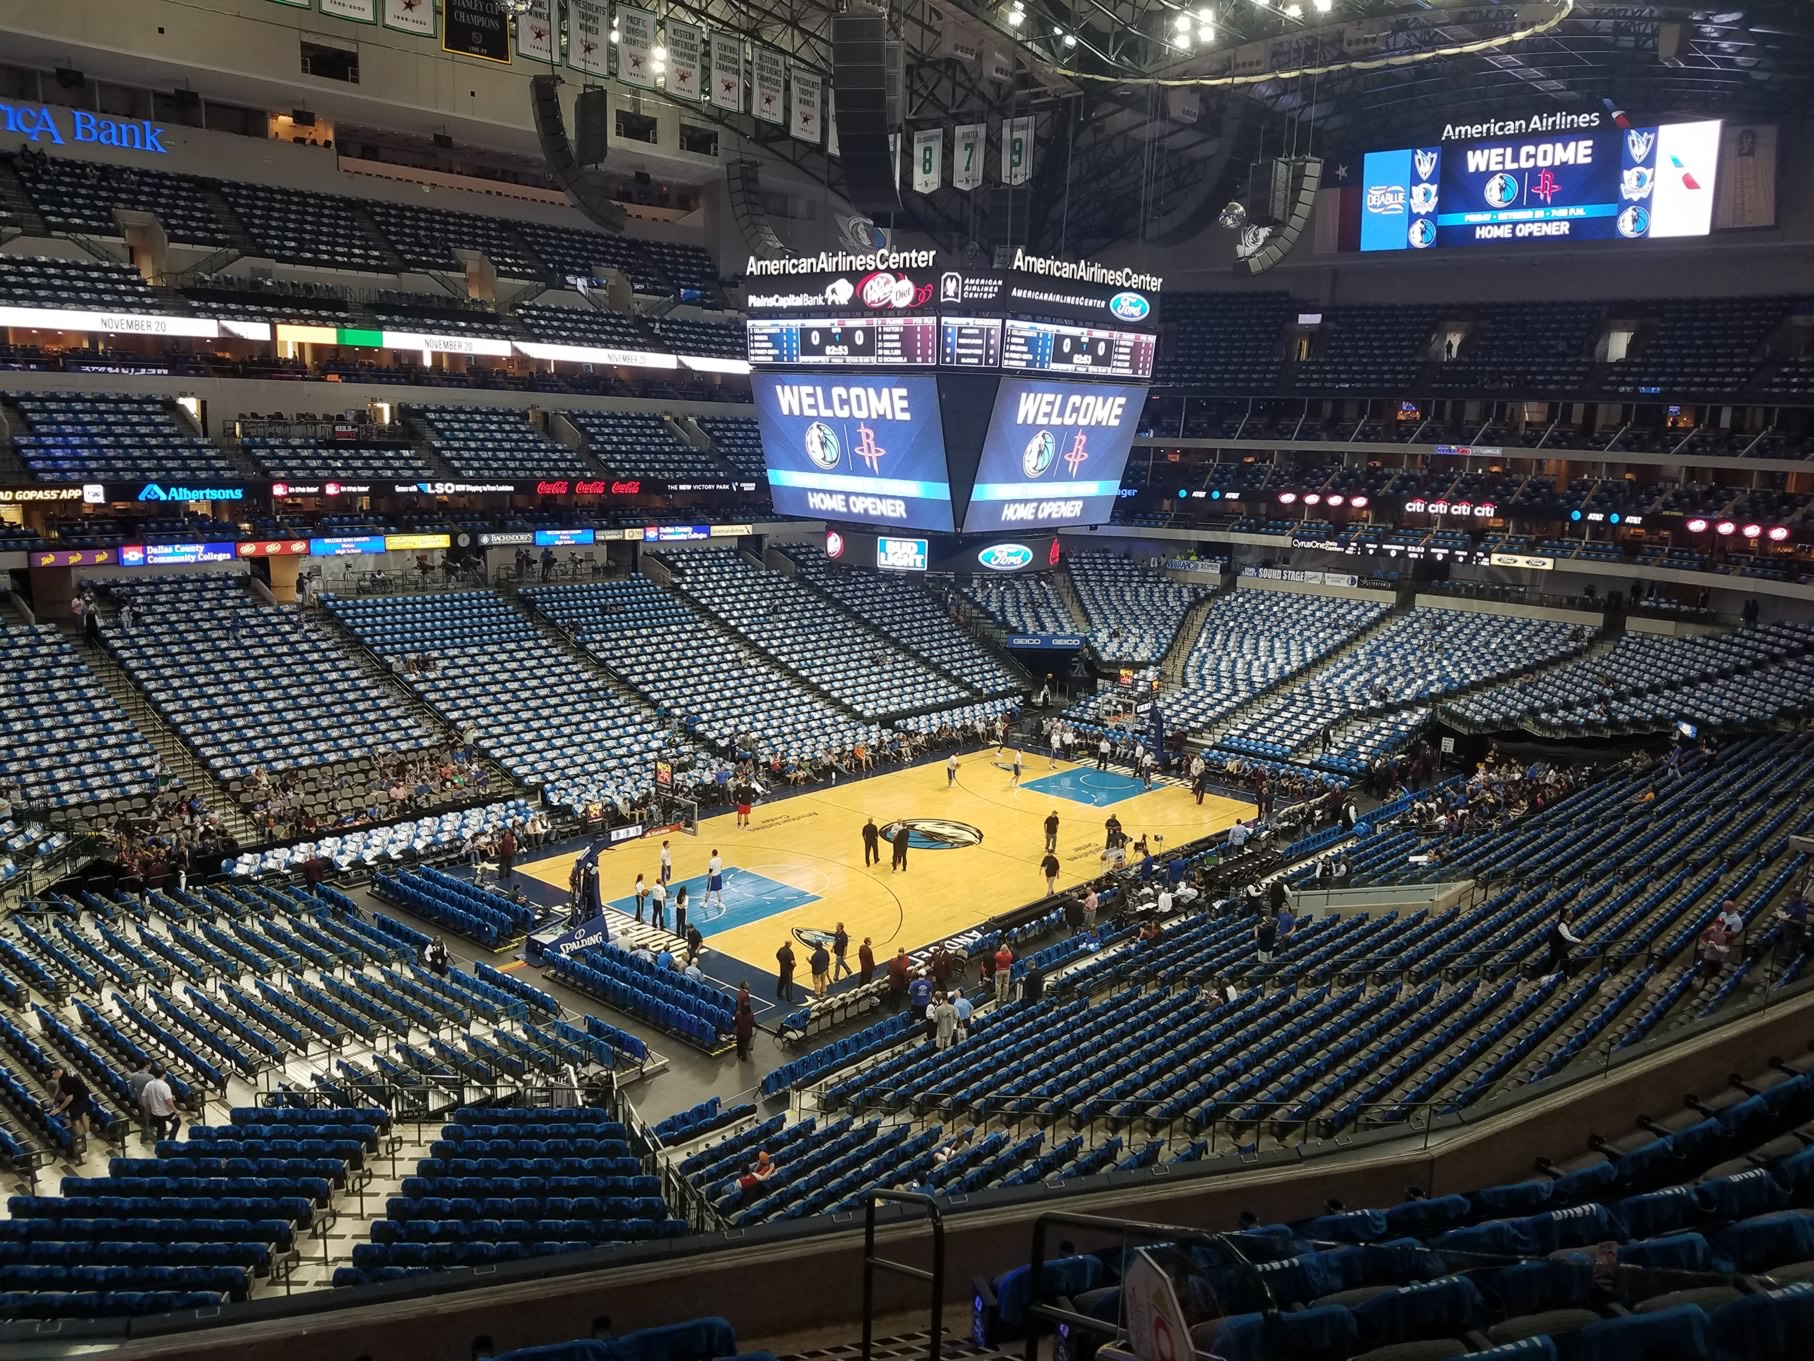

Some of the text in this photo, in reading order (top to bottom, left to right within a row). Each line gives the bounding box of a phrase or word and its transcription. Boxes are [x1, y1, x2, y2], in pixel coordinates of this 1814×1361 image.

[454, 10, 500, 30] CHAMPIONS
[672, 28, 695, 40] WESTERN
[668, 36, 699, 52] CONFERENCE
[71, 110, 167, 153] Bank
[1441, 112, 1600, 141] American Airlines
[922, 146, 932, 174] 8
[964, 143, 974, 172] 7
[1011, 138, 1023, 168] 9
[1467, 140, 1593, 173] WELCOME
[1475, 221, 1570, 239] HOME OPENER
[964, 278, 1002, 286] AMERICAN
[895, 287, 911, 301] Diet
[1118, 296, 1142, 316] Ford
[100, 317, 166, 332] NOVEMBER 20
[424, 338, 473, 351] NOVEMBER 20
[811, 330, 820, 345] 0
[855, 330, 864, 345] 0
[1063, 338, 1071, 353] 0
[1098, 341, 1105, 356] 0
[607, 354, 647, 364] NOVEMBER 20
[776, 385, 911, 421] WELCOME
[1016, 392, 1126, 426] WELCOME
[15, 490, 57, 500] GOPASS
[60, 489, 82, 499] APP
[168, 488, 242, 500] Albertsons
[428, 483, 455, 493] LSO
[807, 491, 906, 518] HOME OPENER
[1002, 500, 1083, 522] HOME OPENER
[1406, 502, 1424, 512] citi
[1428, 503, 1447, 513] citi
[1451, 504, 1470, 515] citi
[1474, 506, 1494, 517] citi
[1588, 513, 1604, 521] AT&T
[1625, 516, 1642, 524] AT&T
[147, 544, 204, 554] Dallas County
[885, 541, 918, 554] BUD
[1293, 540, 1326, 550] CyrusOne
[147, 552, 231, 563] Community Colleges
[880, 552, 925, 567] LIGHT
[990, 551, 1023, 565] Ford
[1259, 568, 1281, 579] SOUND
[1283, 570, 1305, 581] STAGE
[560, 932, 602, 954] SPALDING
